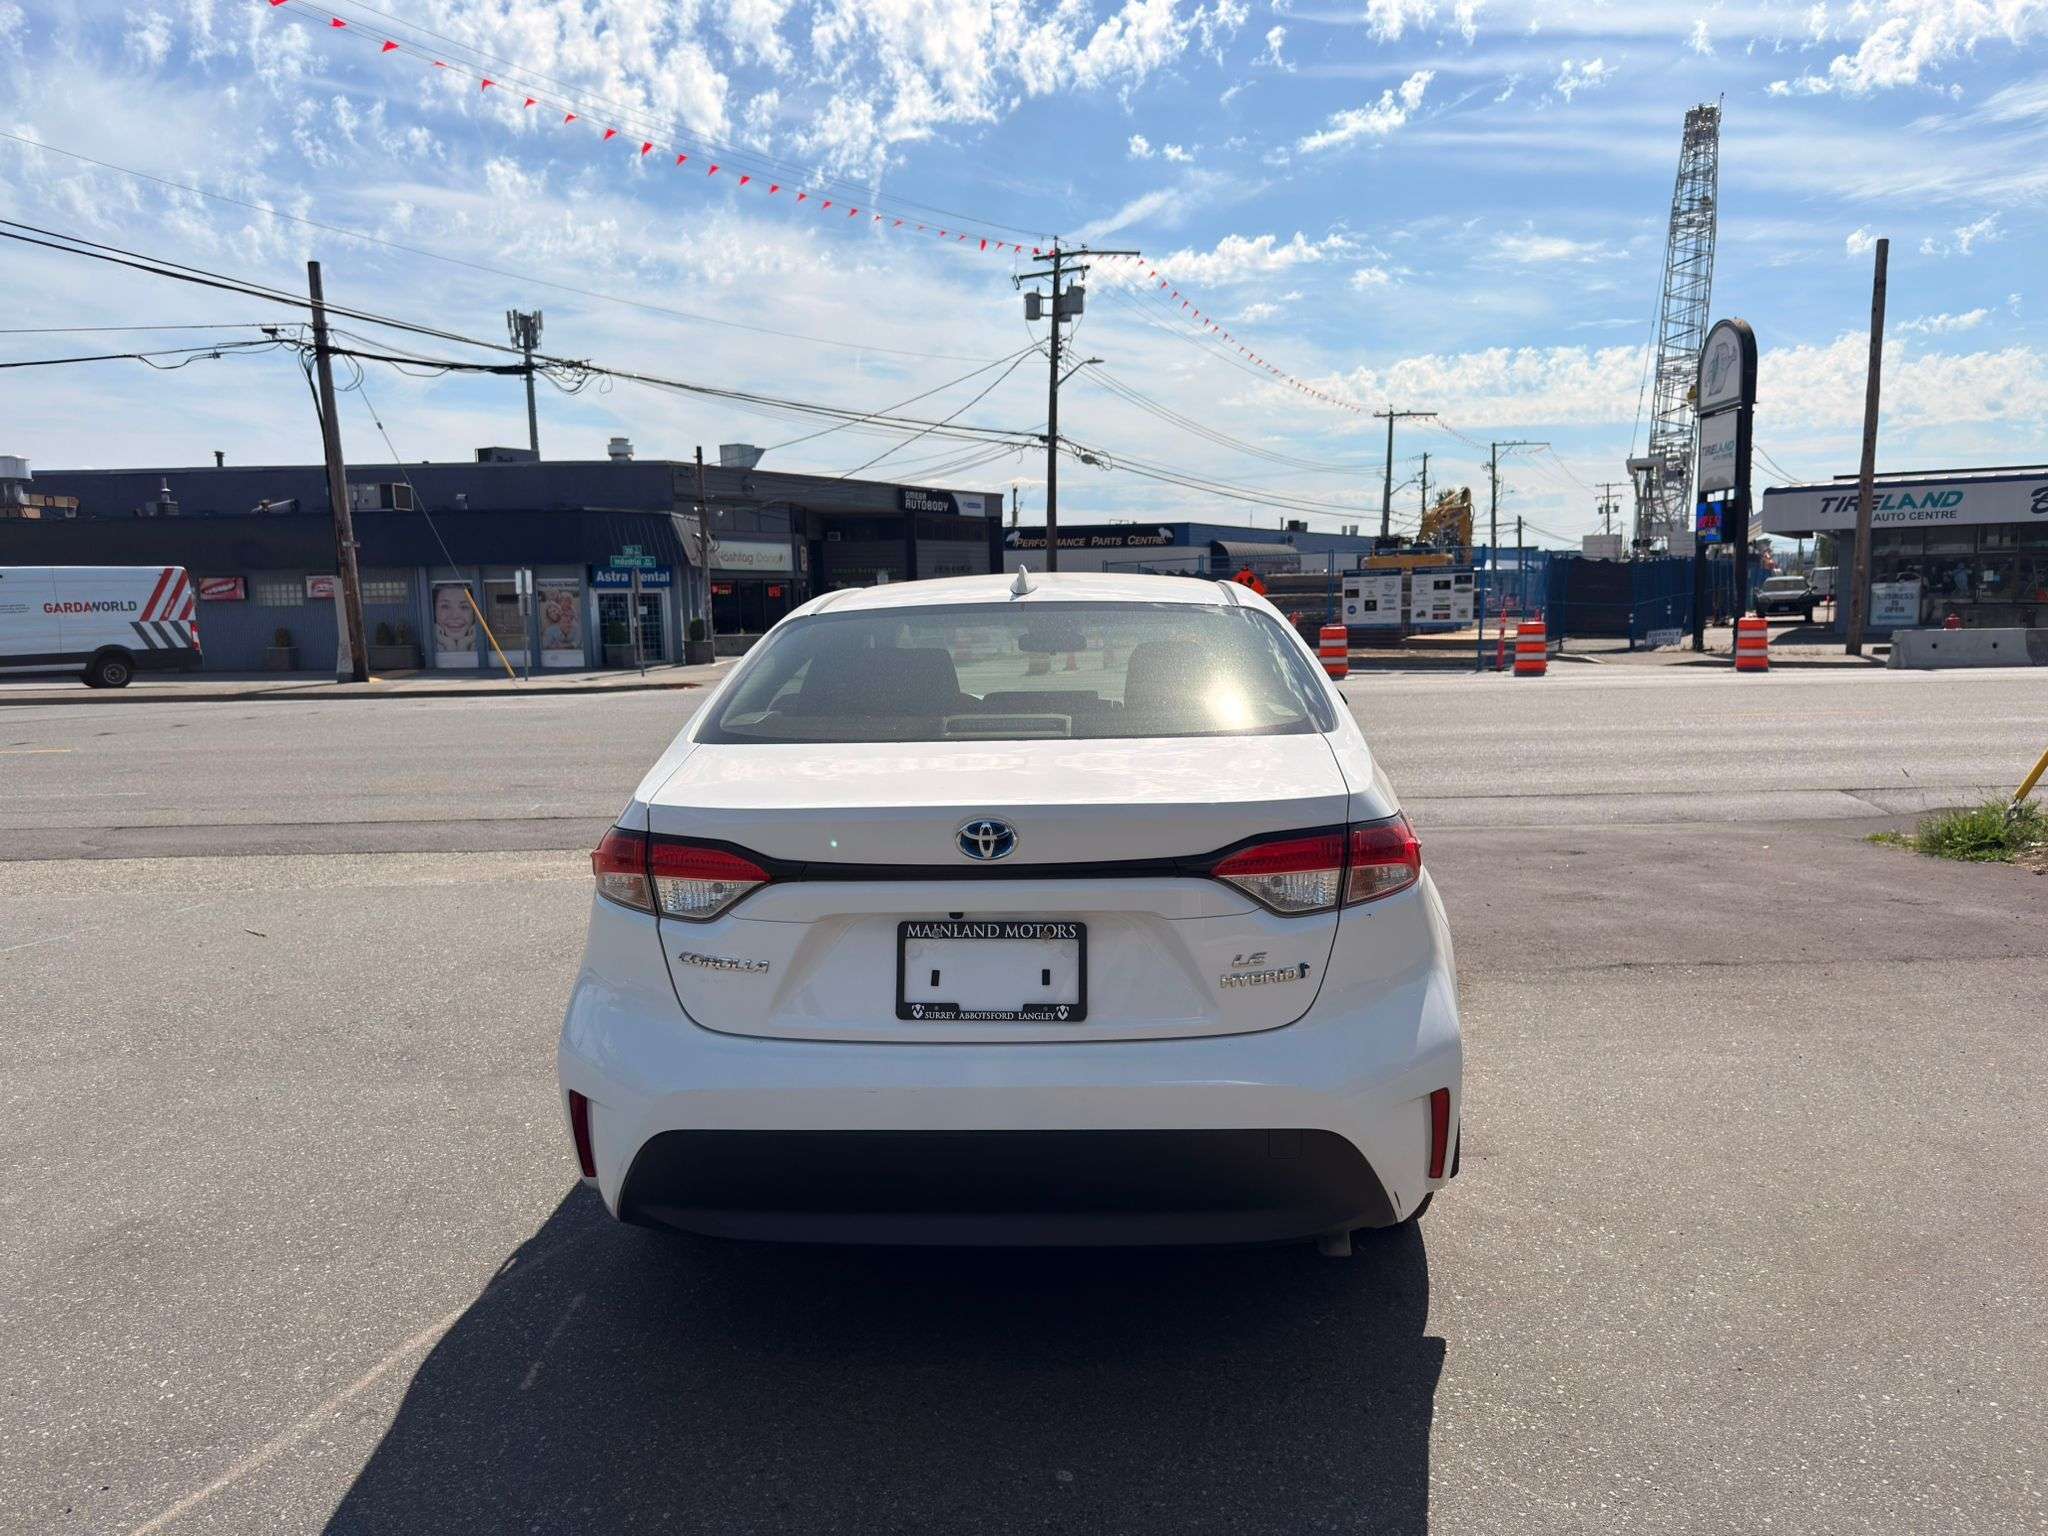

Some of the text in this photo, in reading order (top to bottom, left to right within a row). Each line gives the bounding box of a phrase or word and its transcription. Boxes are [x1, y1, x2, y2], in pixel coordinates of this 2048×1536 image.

[904, 499, 949, 512] AUTOBODY
[1873, 510, 1957, 522] AUTO CENTRE
[1015, 534, 1167, 547] PERFOANCE PARTS CENTRE
[596, 570, 670, 582] Astra ental
[43, 600, 137, 614] GARDAWORLD
[906, 923, 1077, 938] MAINLAND MOTORS
[679, 951, 769, 973] COROLLA
[1232, 952, 1268, 968] LE
[1219, 966, 1296, 988] HYBRID
[924, 1011, 1055, 1020] SURREY ABBOTSFORD LANGLEY
